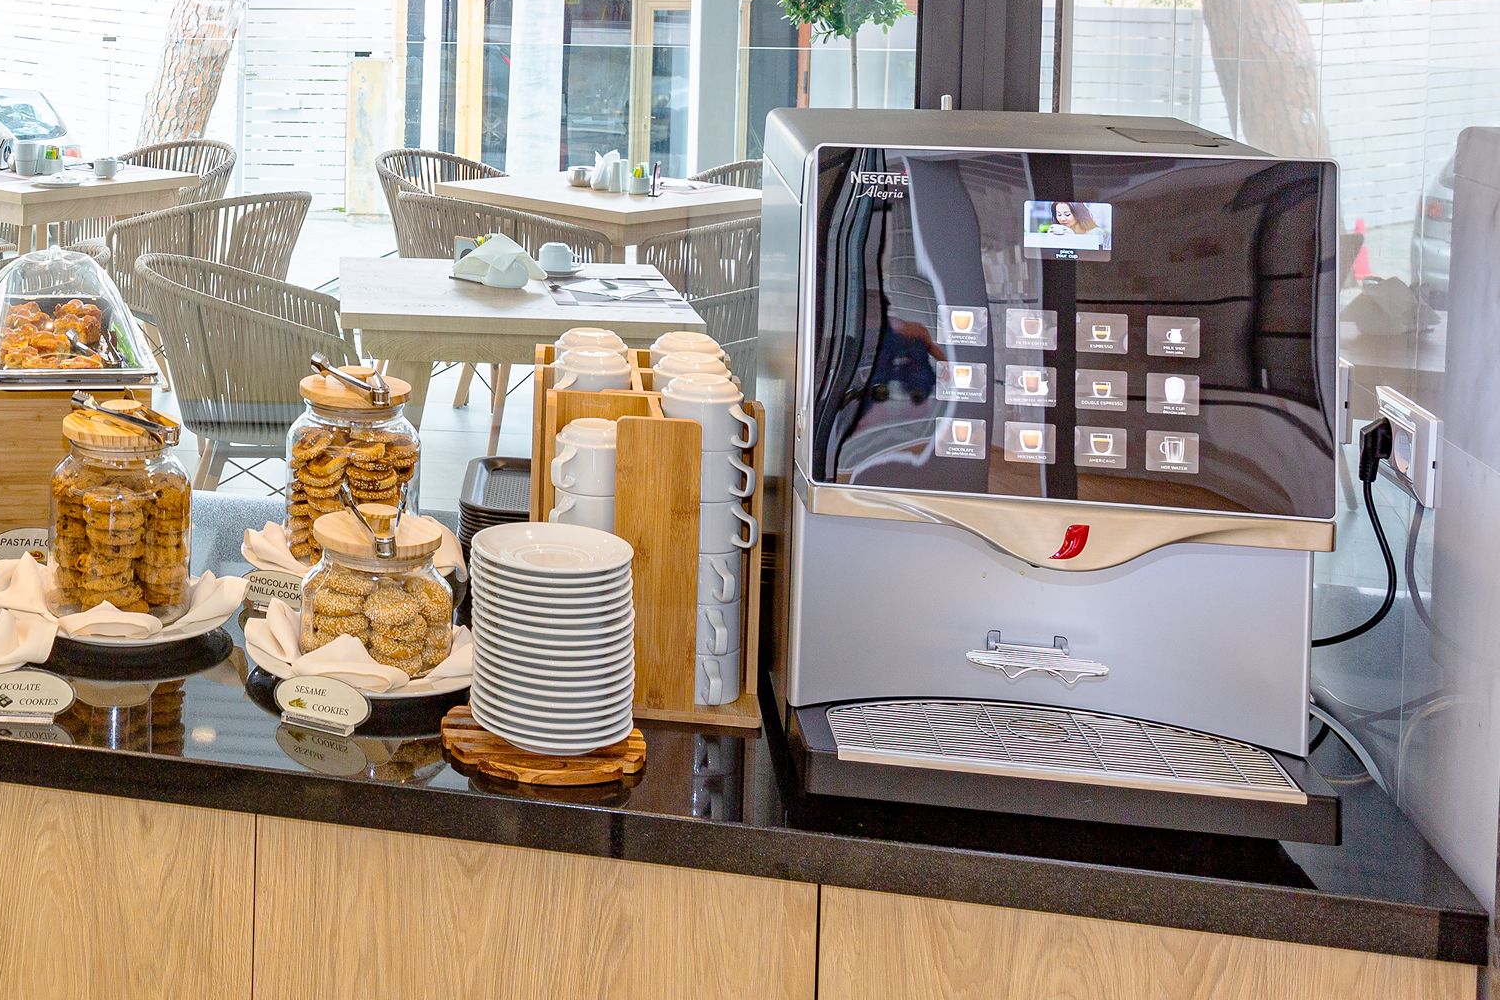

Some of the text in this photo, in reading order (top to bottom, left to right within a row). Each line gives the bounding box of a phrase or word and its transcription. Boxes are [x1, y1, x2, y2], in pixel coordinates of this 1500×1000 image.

[856, 185, 904, 200] Alegria
[0, 538, 31, 546] PASTA
[249, 575, 300, 591] CHOCOLATE
[294, 685, 327, 697] SESAME
[19, 698, 58, 706] COOKIES
[311, 703, 349, 716] COOKIES
